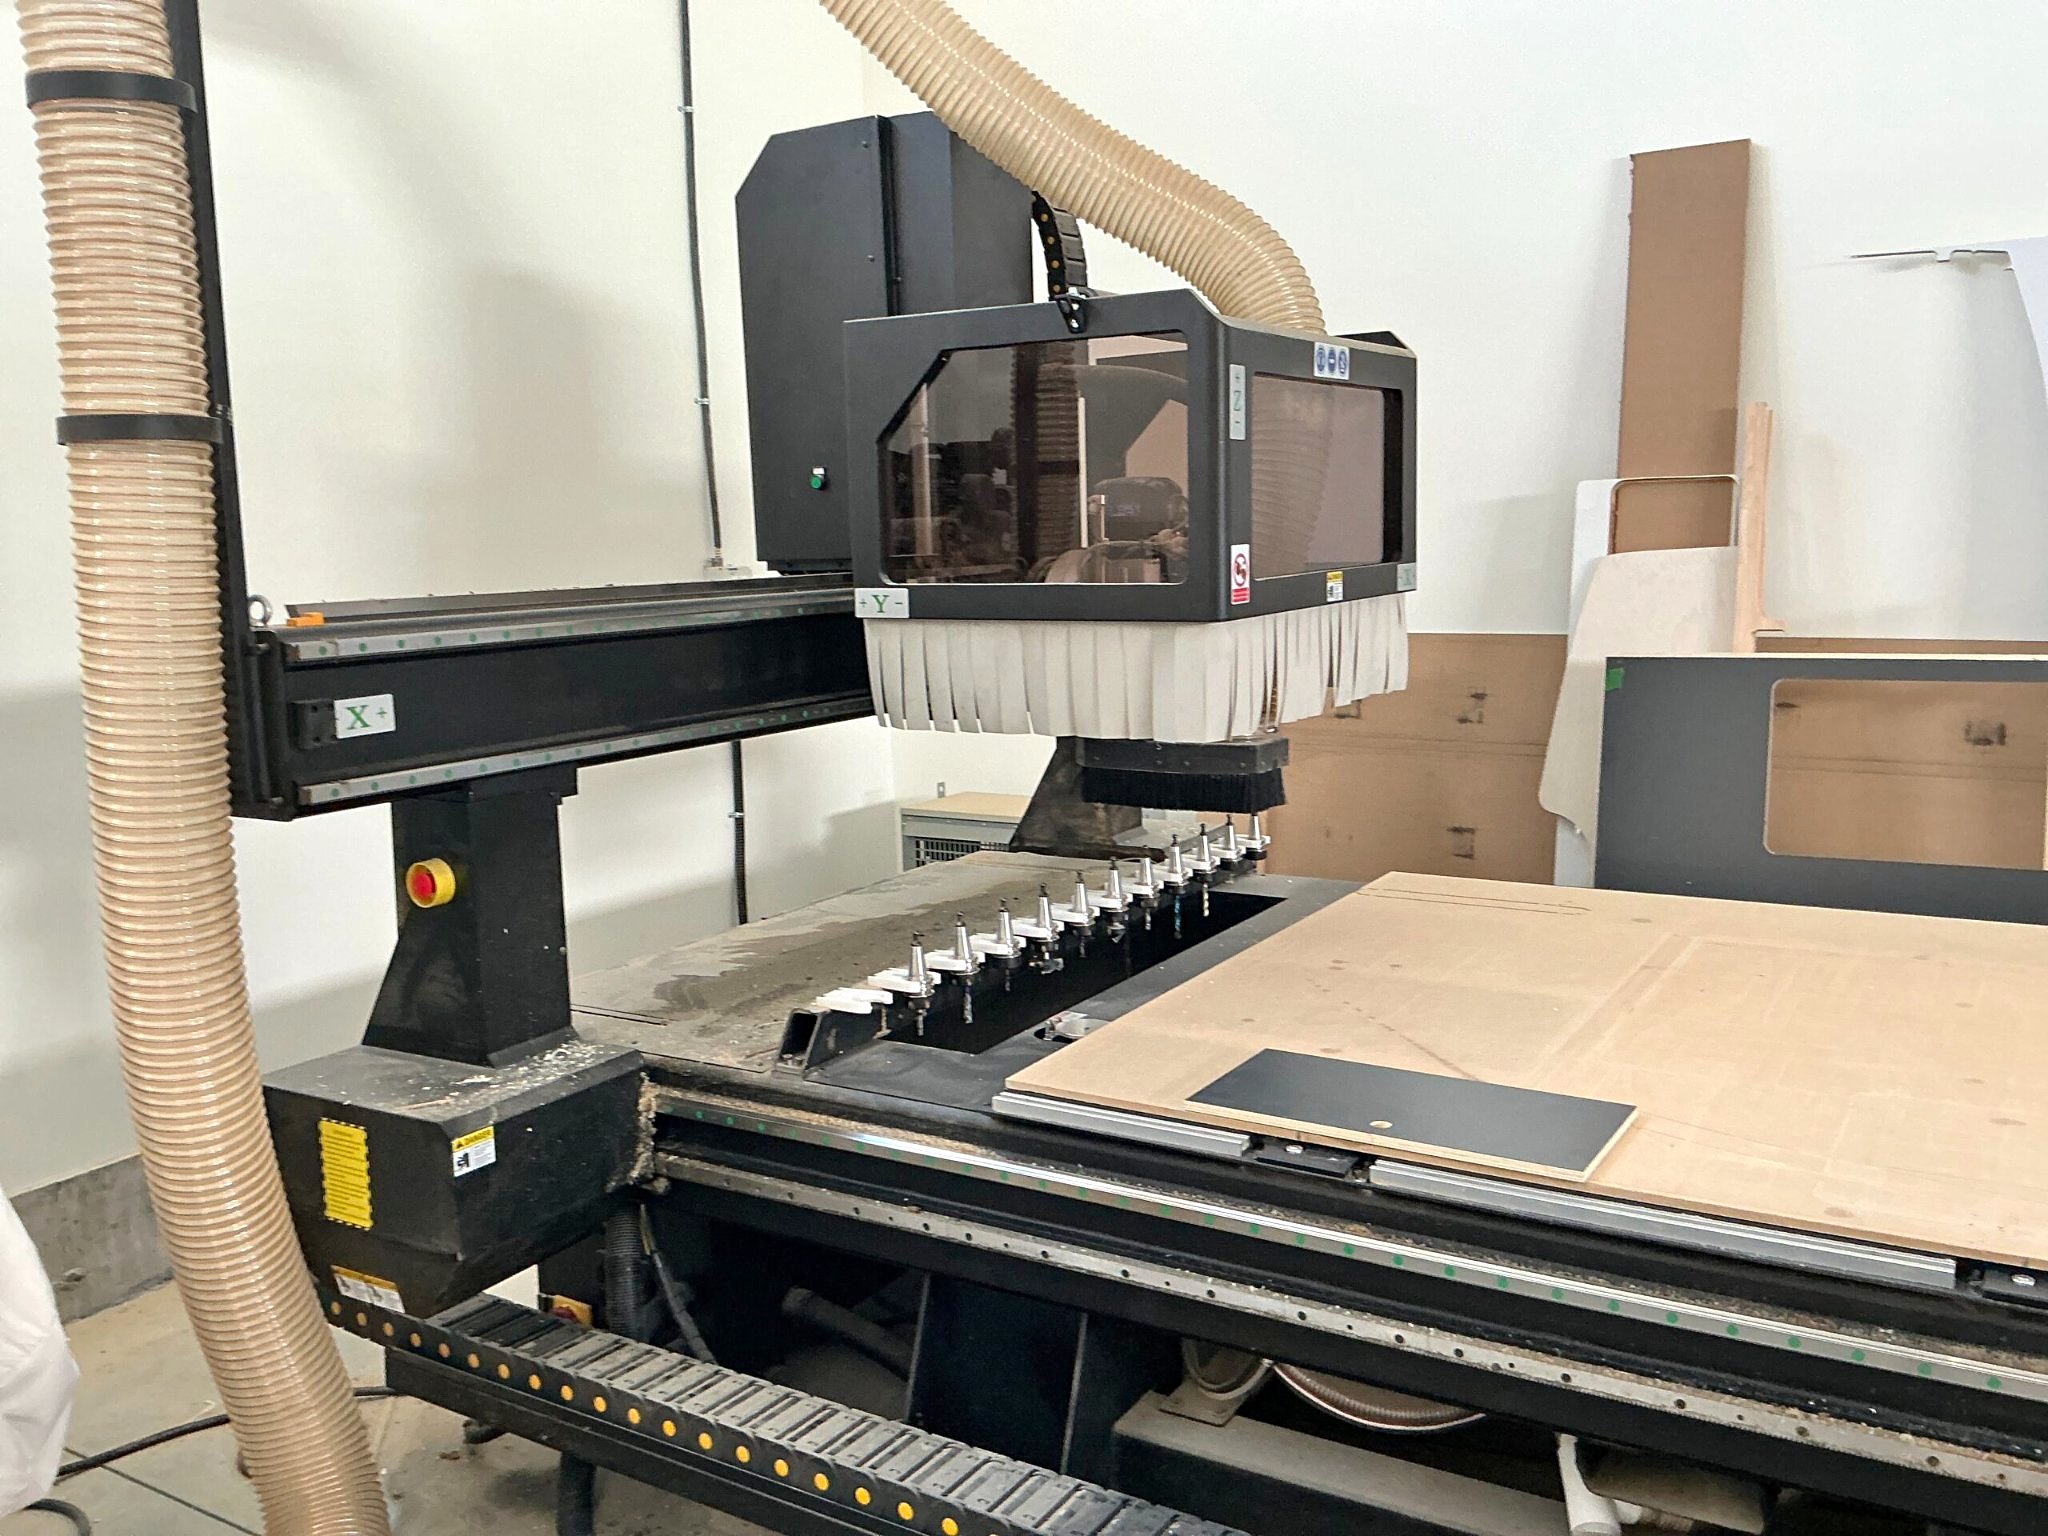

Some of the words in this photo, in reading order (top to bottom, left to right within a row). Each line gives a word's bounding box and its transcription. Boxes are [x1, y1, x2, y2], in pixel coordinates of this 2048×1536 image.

[1233, 390, 1241, 411] Z
[871, 594, 890, 613] Y
[345, 704, 371, 730] X
